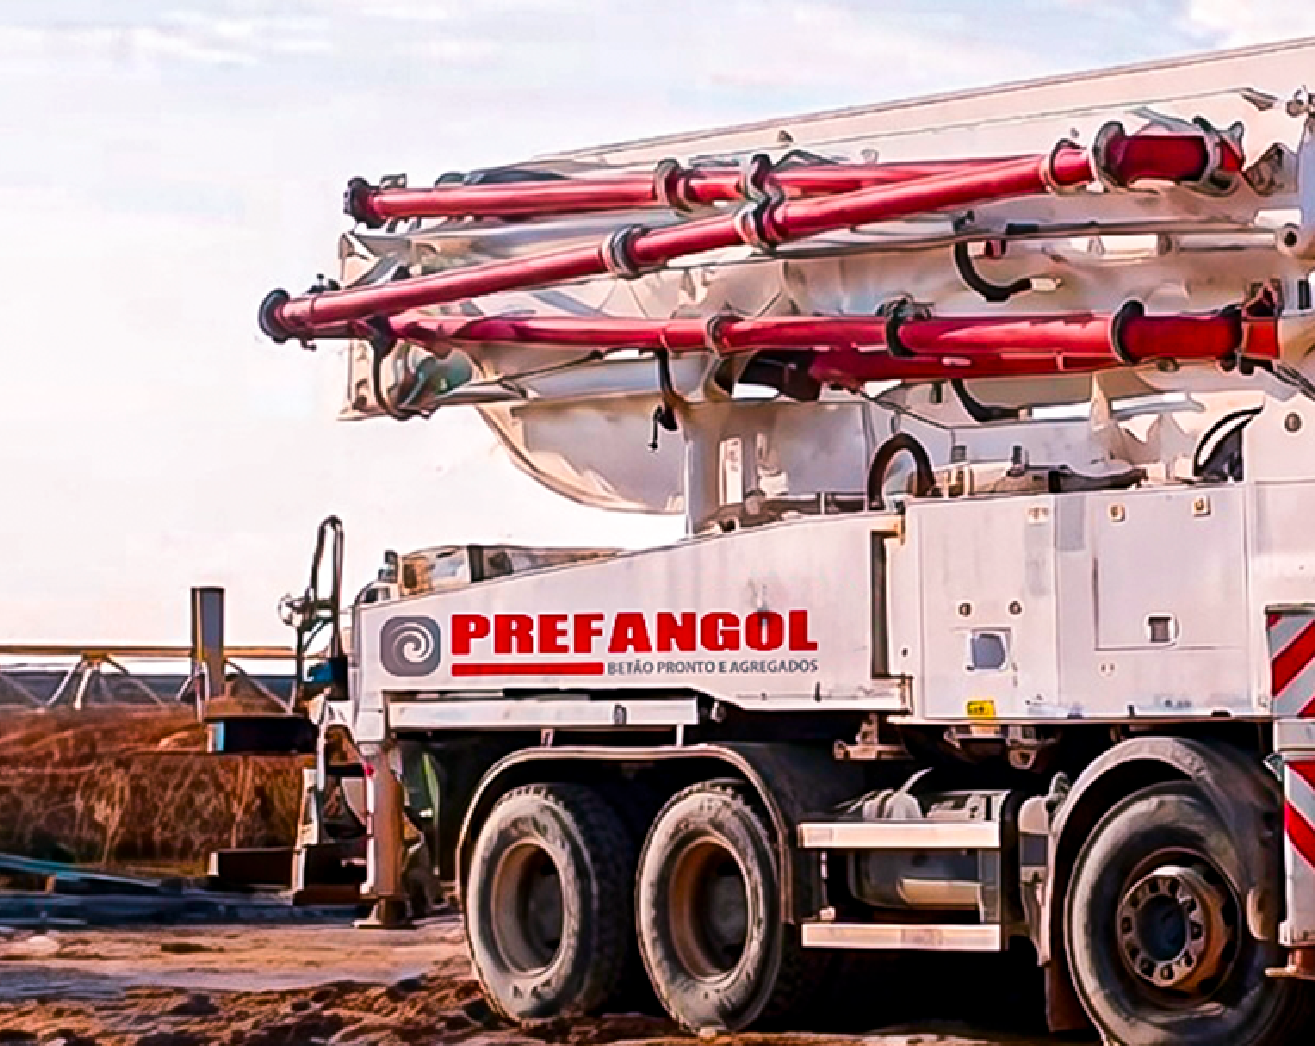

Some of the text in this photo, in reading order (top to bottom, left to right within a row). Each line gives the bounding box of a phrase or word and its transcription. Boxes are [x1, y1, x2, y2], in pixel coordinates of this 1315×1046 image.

[451, 609, 819, 656] PREFANGOL
[607, 658, 818, 675] BETÃO PRONTO E AGREGADOS
